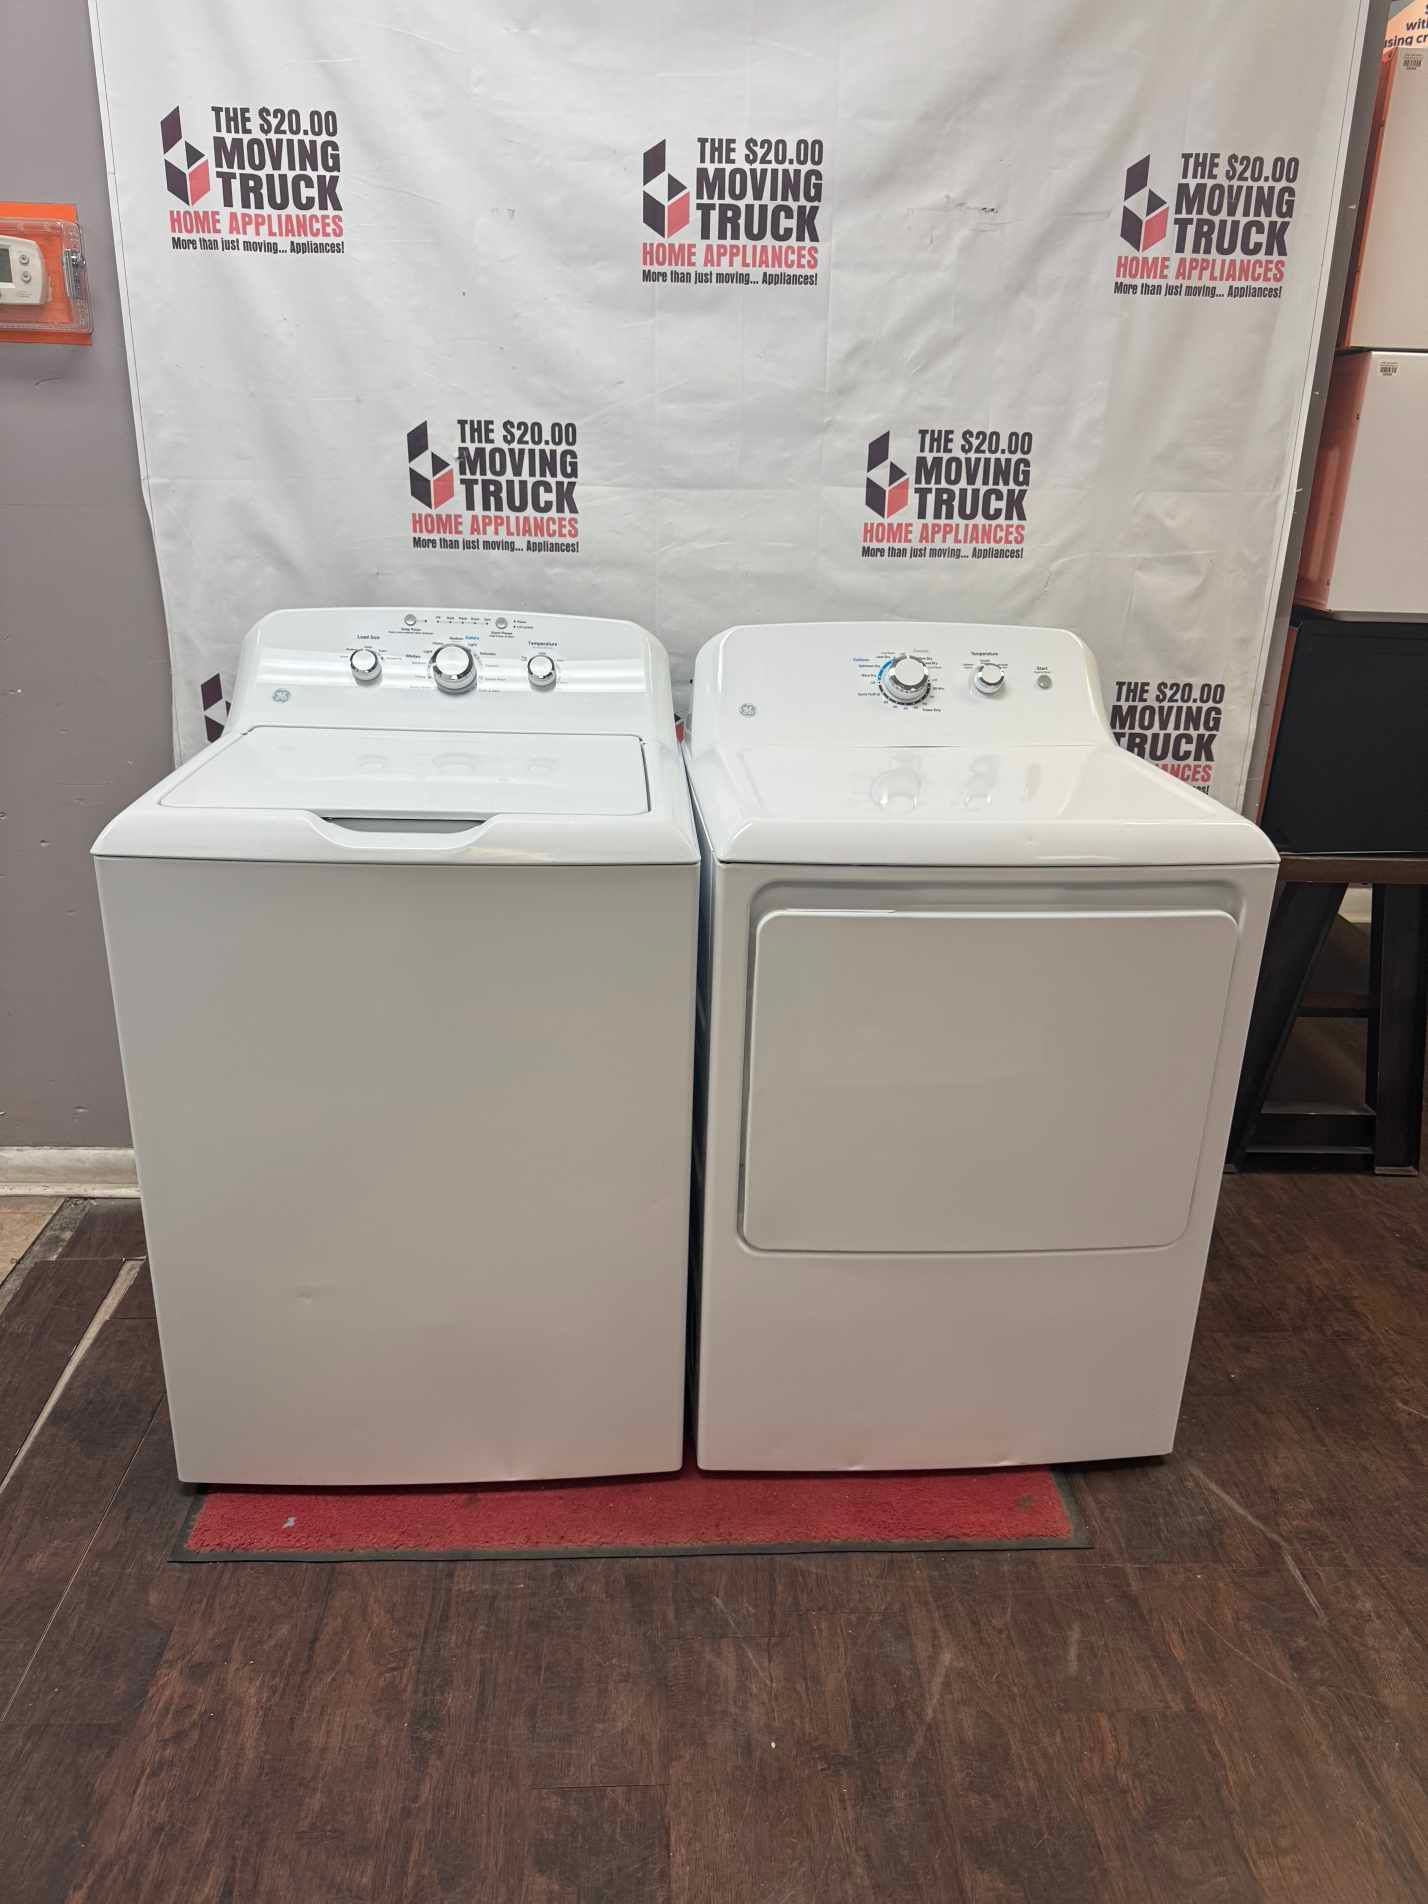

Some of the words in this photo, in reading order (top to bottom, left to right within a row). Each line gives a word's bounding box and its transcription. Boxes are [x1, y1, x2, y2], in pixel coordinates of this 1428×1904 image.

[211, 106, 252, 134] THE
[258, 106, 337, 136] $20.00
[213, 136, 340, 172] MOVING
[697, 137, 736, 164] THE
[745, 137, 823, 166] $20.00
[1181, 153, 1220, 179] THE
[1226, 153, 1300, 183] $20.00
[216, 171, 343, 211] TRUCK
[696, 168, 822, 202] MOVING
[1175, 183, 1295, 218] MOVING
[169, 210, 221, 233] HOME
[229, 212, 343, 237] APPLIANCES
[696, 203, 819, 242] TRUCK
[172, 237, 197, 249] More
[200, 238, 218, 250] than
[221, 238, 239, 251] just
[243, 240, 287, 253] moving...
[290, 241, 344, 254] Appliances!
[1174, 217, 1290, 256] TRUCK
[642, 242, 696, 266] HOME
[704, 244, 818, 269] APPLIANCES
[1116, 256, 1170, 279] HOME
[1175, 257, 1286, 282] APPLIANCES
[642, 269, 667, 283] More
[671, 270, 691, 283] than
[694, 270, 712, 284] just
[716, 271, 758, 285] moving...
[762, 272, 817, 285] Appliances!
[1114, 282, 1137, 295] More
[1141, 282, 1162, 296] than
[1164, 282, 1182, 296] just
[1185, 283, 1224, 298] moving...
[1228, 285, 1282, 298] Appliances!
[457, 419, 494, 444] THE
[502, 419, 577, 446] $20.00
[919, 430, 954, 453] THE
[961, 429, 1033, 455] $20.00
[458, 447, 578, 478] MOVING
[914, 457, 1030, 487] MOVING
[460, 479, 578, 514] TRUCK
[914, 488, 1027, 521] TRUCK
[411, 513, 462, 535] HOME
[470, 515, 578, 538] APPLIANCES
[863, 522, 912, 543] HOME
[919, 524, 1025, 544] APPLIANCES
[413, 537, 437, 548] More
[439, 538, 459, 549] than
[462, 538, 480, 551] just
[483, 539, 523, 552] moving...
[526, 540, 579, 553] Appliances!
[862, 546, 885, 557] More
[888, 547, 906, 558] than
[910, 546, 926, 558] just
[929, 547, 969, 559] moving...
[971, 547, 1023, 559] Appliances!
[1116, 681, 1150, 702] THE
[1156, 681, 1225, 704] $20.00
[1110, 705, 1222, 732] MOVING
